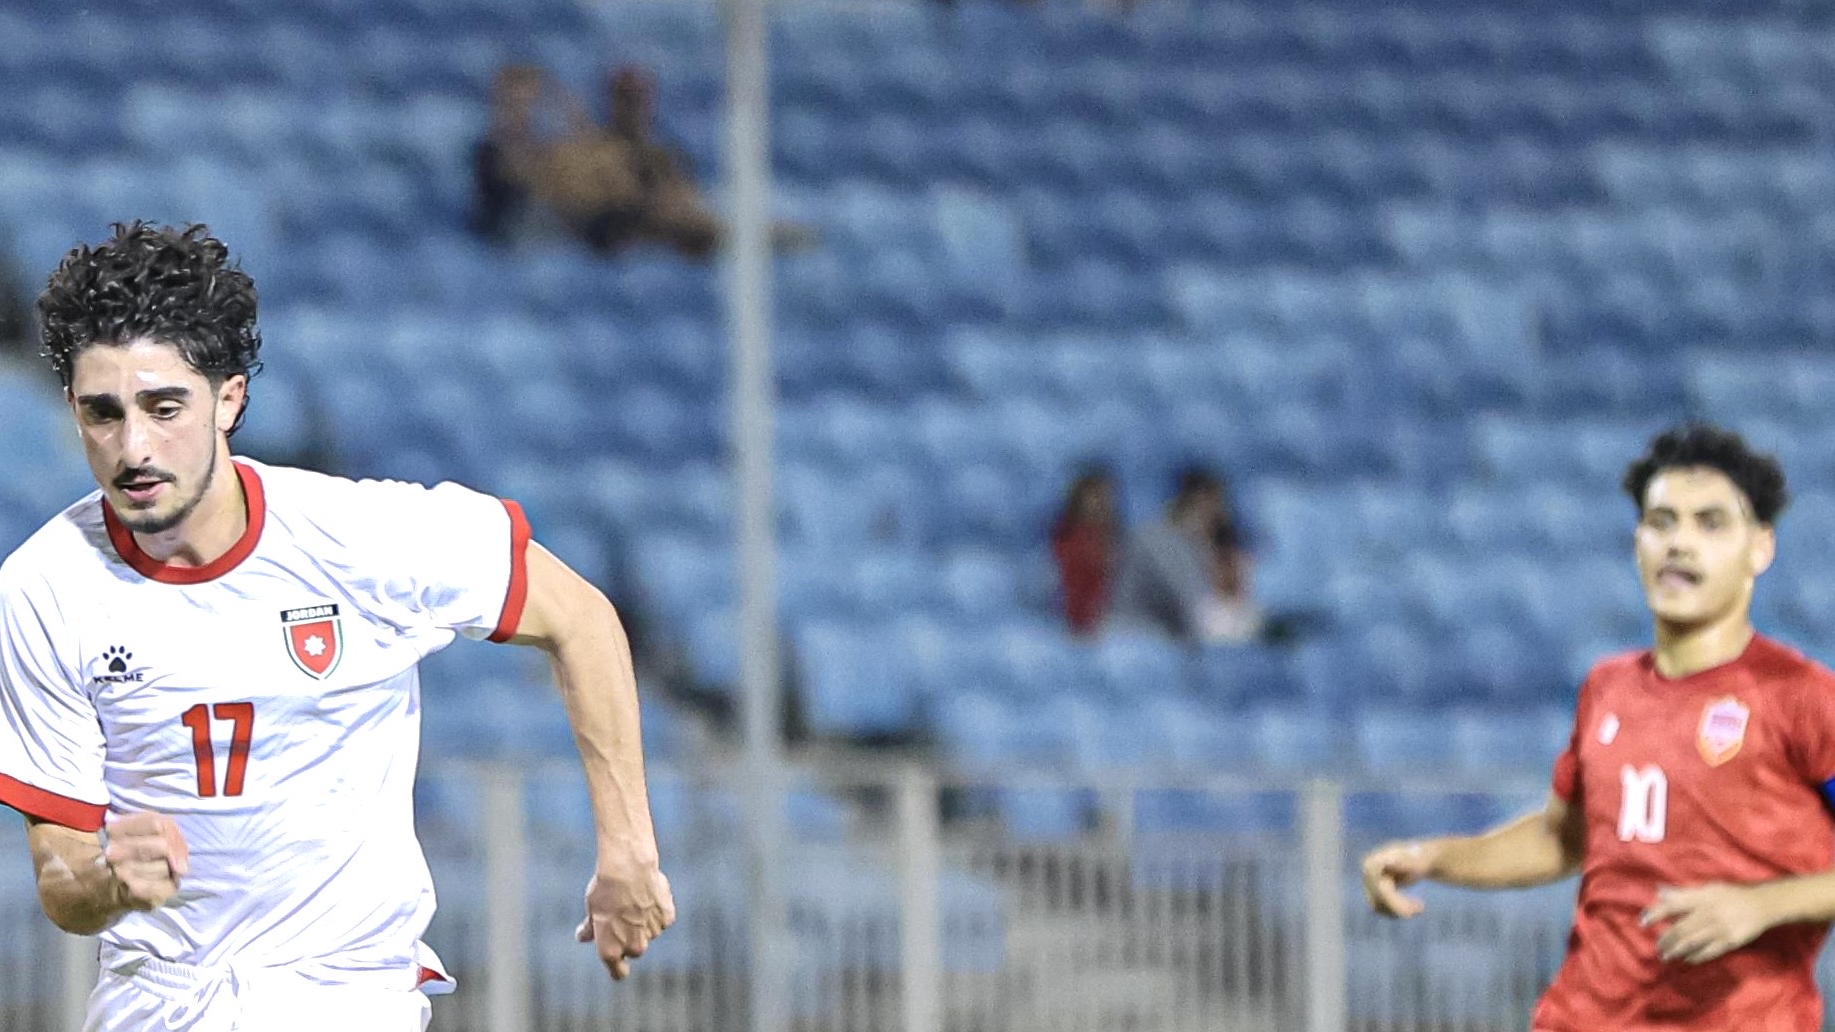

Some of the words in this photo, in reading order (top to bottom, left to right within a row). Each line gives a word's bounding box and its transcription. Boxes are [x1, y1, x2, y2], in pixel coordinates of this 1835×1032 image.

[286, 605, 334, 622] JORDAN
[181, 702, 254, 798] 17
[1618, 763, 1667, 843] 10
